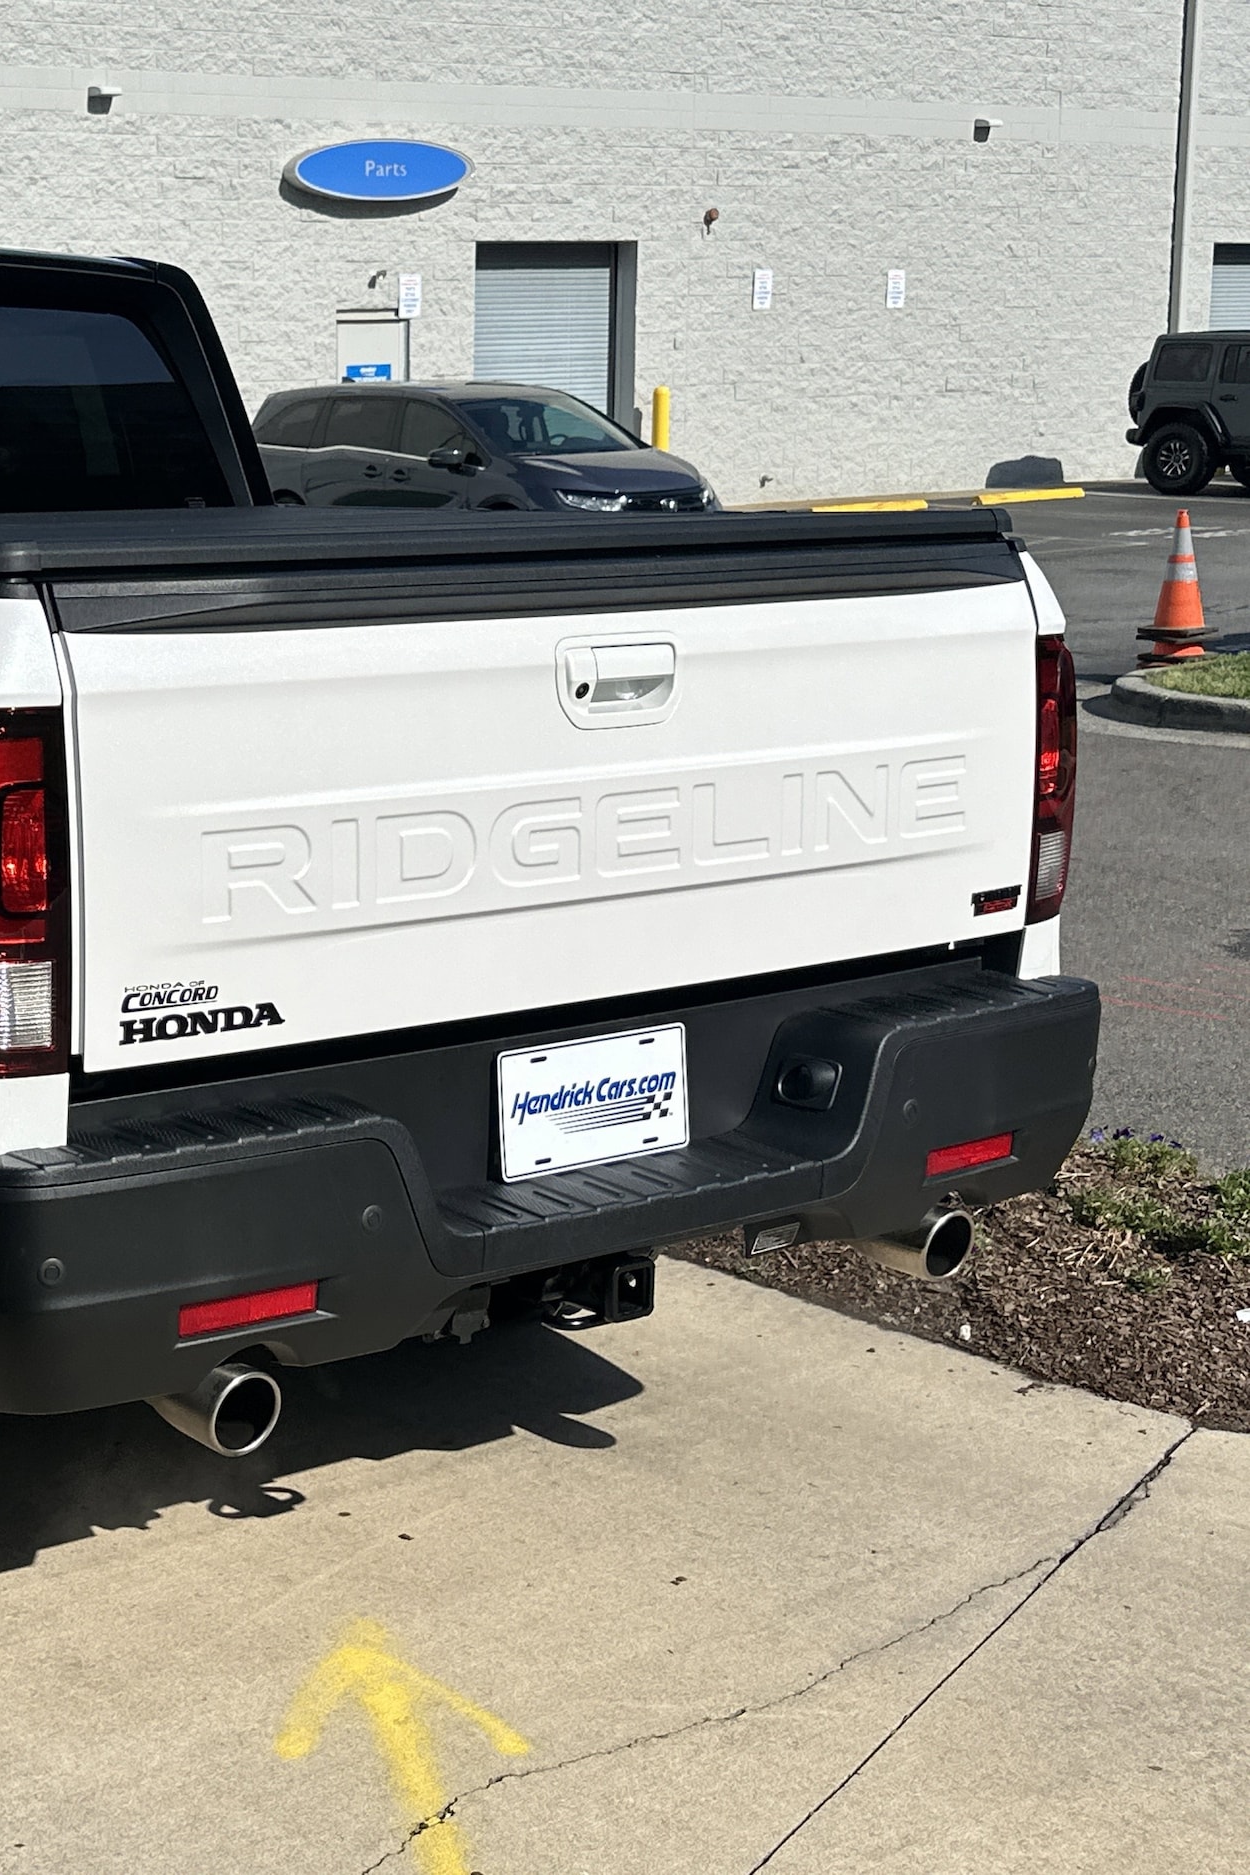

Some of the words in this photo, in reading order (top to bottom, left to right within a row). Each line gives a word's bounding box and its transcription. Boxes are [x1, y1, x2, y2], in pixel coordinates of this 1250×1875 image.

[364, 160, 408, 177] Parts
[201, 754, 968, 924] RIDGELINE
[121, 985, 219, 1013] CONCORD
[124, 981, 185, 993] HONDA
[188, 979, 205, 988] OF
[118, 1001, 286, 1046] HONDA
